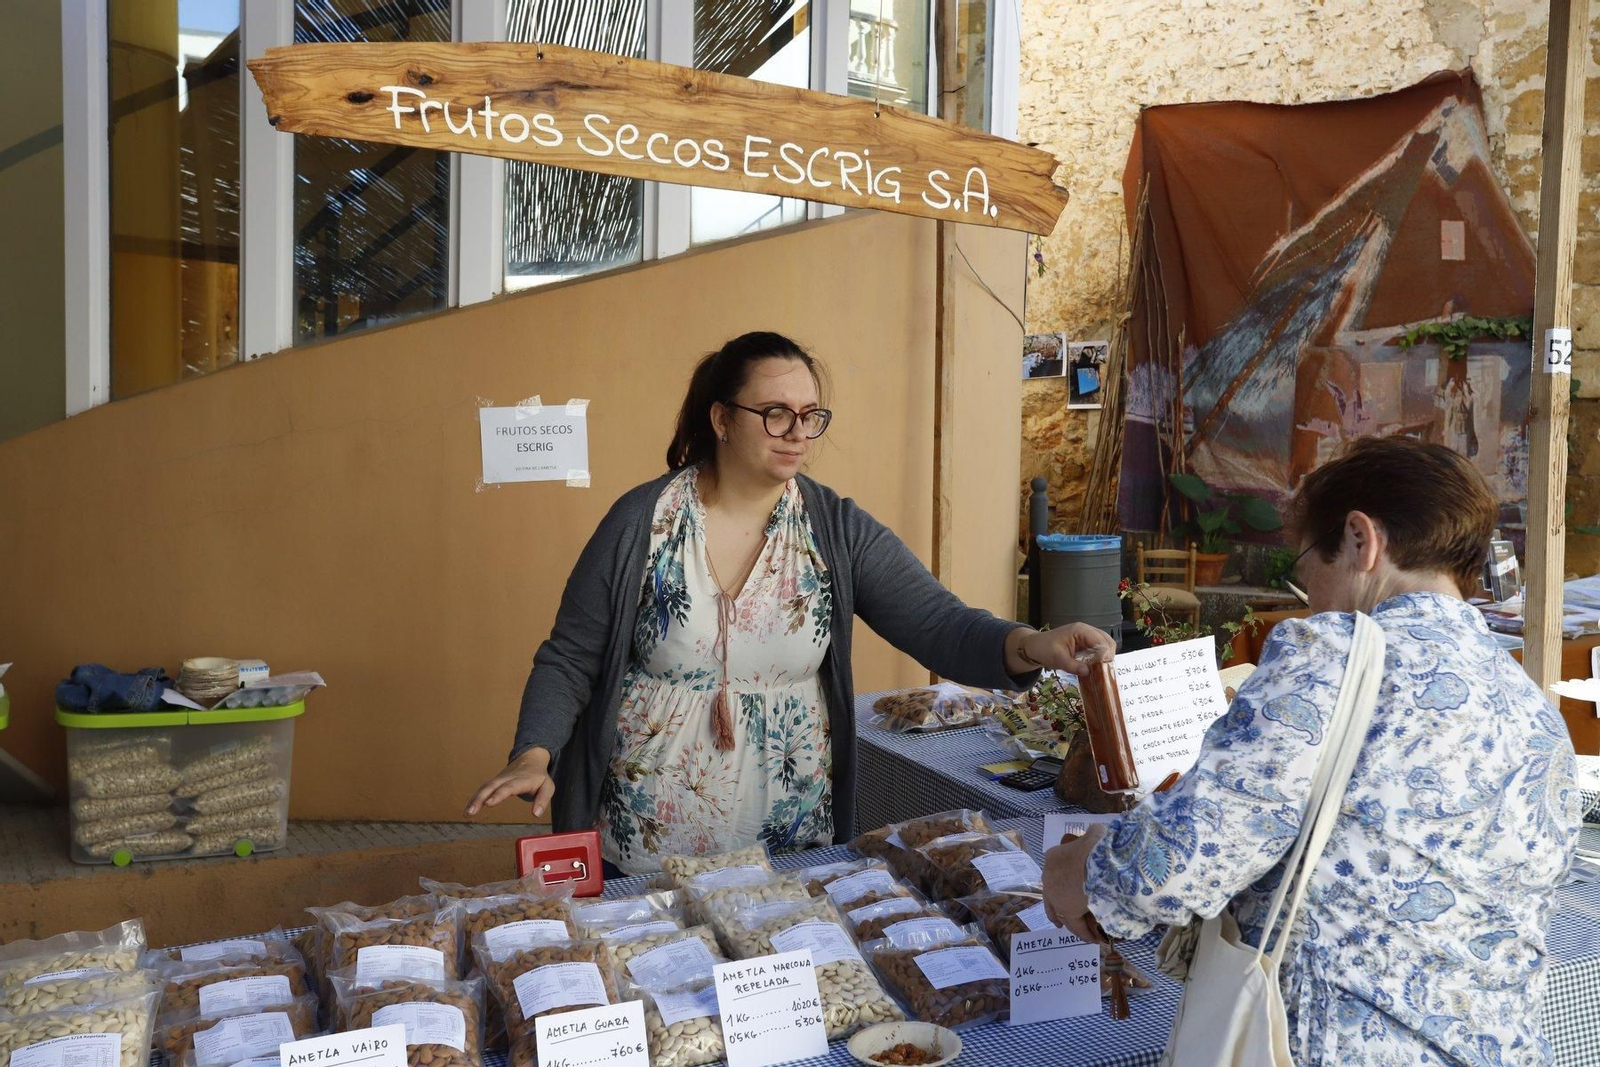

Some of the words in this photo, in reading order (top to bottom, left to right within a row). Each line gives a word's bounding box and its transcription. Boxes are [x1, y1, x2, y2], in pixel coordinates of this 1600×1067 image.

[380, 85, 564, 147] Frutos
[577, 113, 730, 171] Secos
[922, 167, 998, 217] S.A.
[1548, 339, 1572, 365] 52
[495, 426, 538, 436] FRUTOS
[540, 424, 573, 435] SECOS
[516, 442, 554, 453] ESCRIG
[1016, 938, 1053, 951] AMETLA
[722, 967, 766, 983] AMETLA
[773, 959, 811, 973] MARCONA
[1068, 958, 1098, 971] 8'50€
[735, 977, 789, 994] REPELADA
[1069, 973, 1097, 985] 4'50€
[546, 1022, 587, 1039] AMETLA
[594, 1016, 629, 1031] GUARA
[288, 1048, 340, 1066] AMETLA
